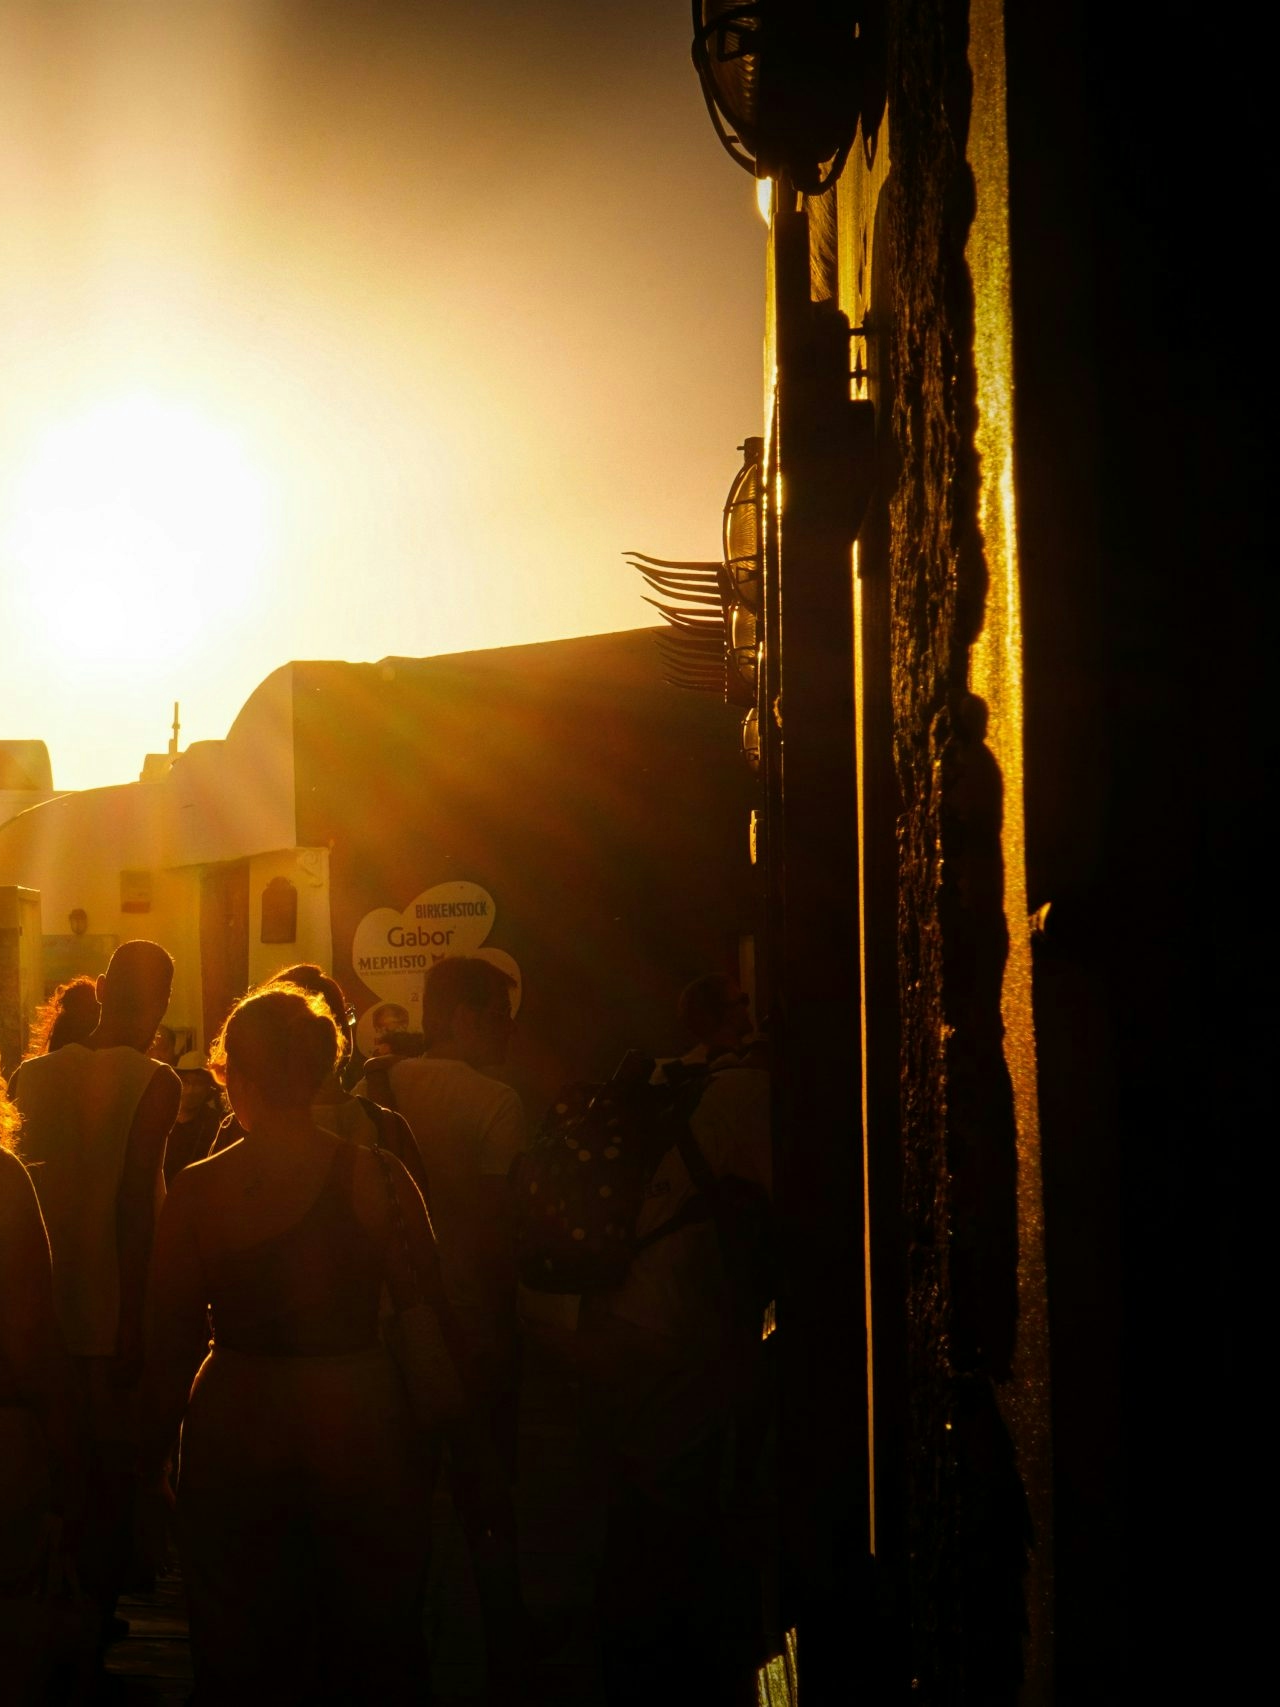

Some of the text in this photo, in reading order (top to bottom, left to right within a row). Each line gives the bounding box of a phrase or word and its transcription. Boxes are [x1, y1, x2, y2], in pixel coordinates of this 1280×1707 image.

[415, 901, 488, 918] BIRKENSTOCK
[387, 926, 455, 947] Gabor
[358, 954, 427, 970] MEPHISTO
